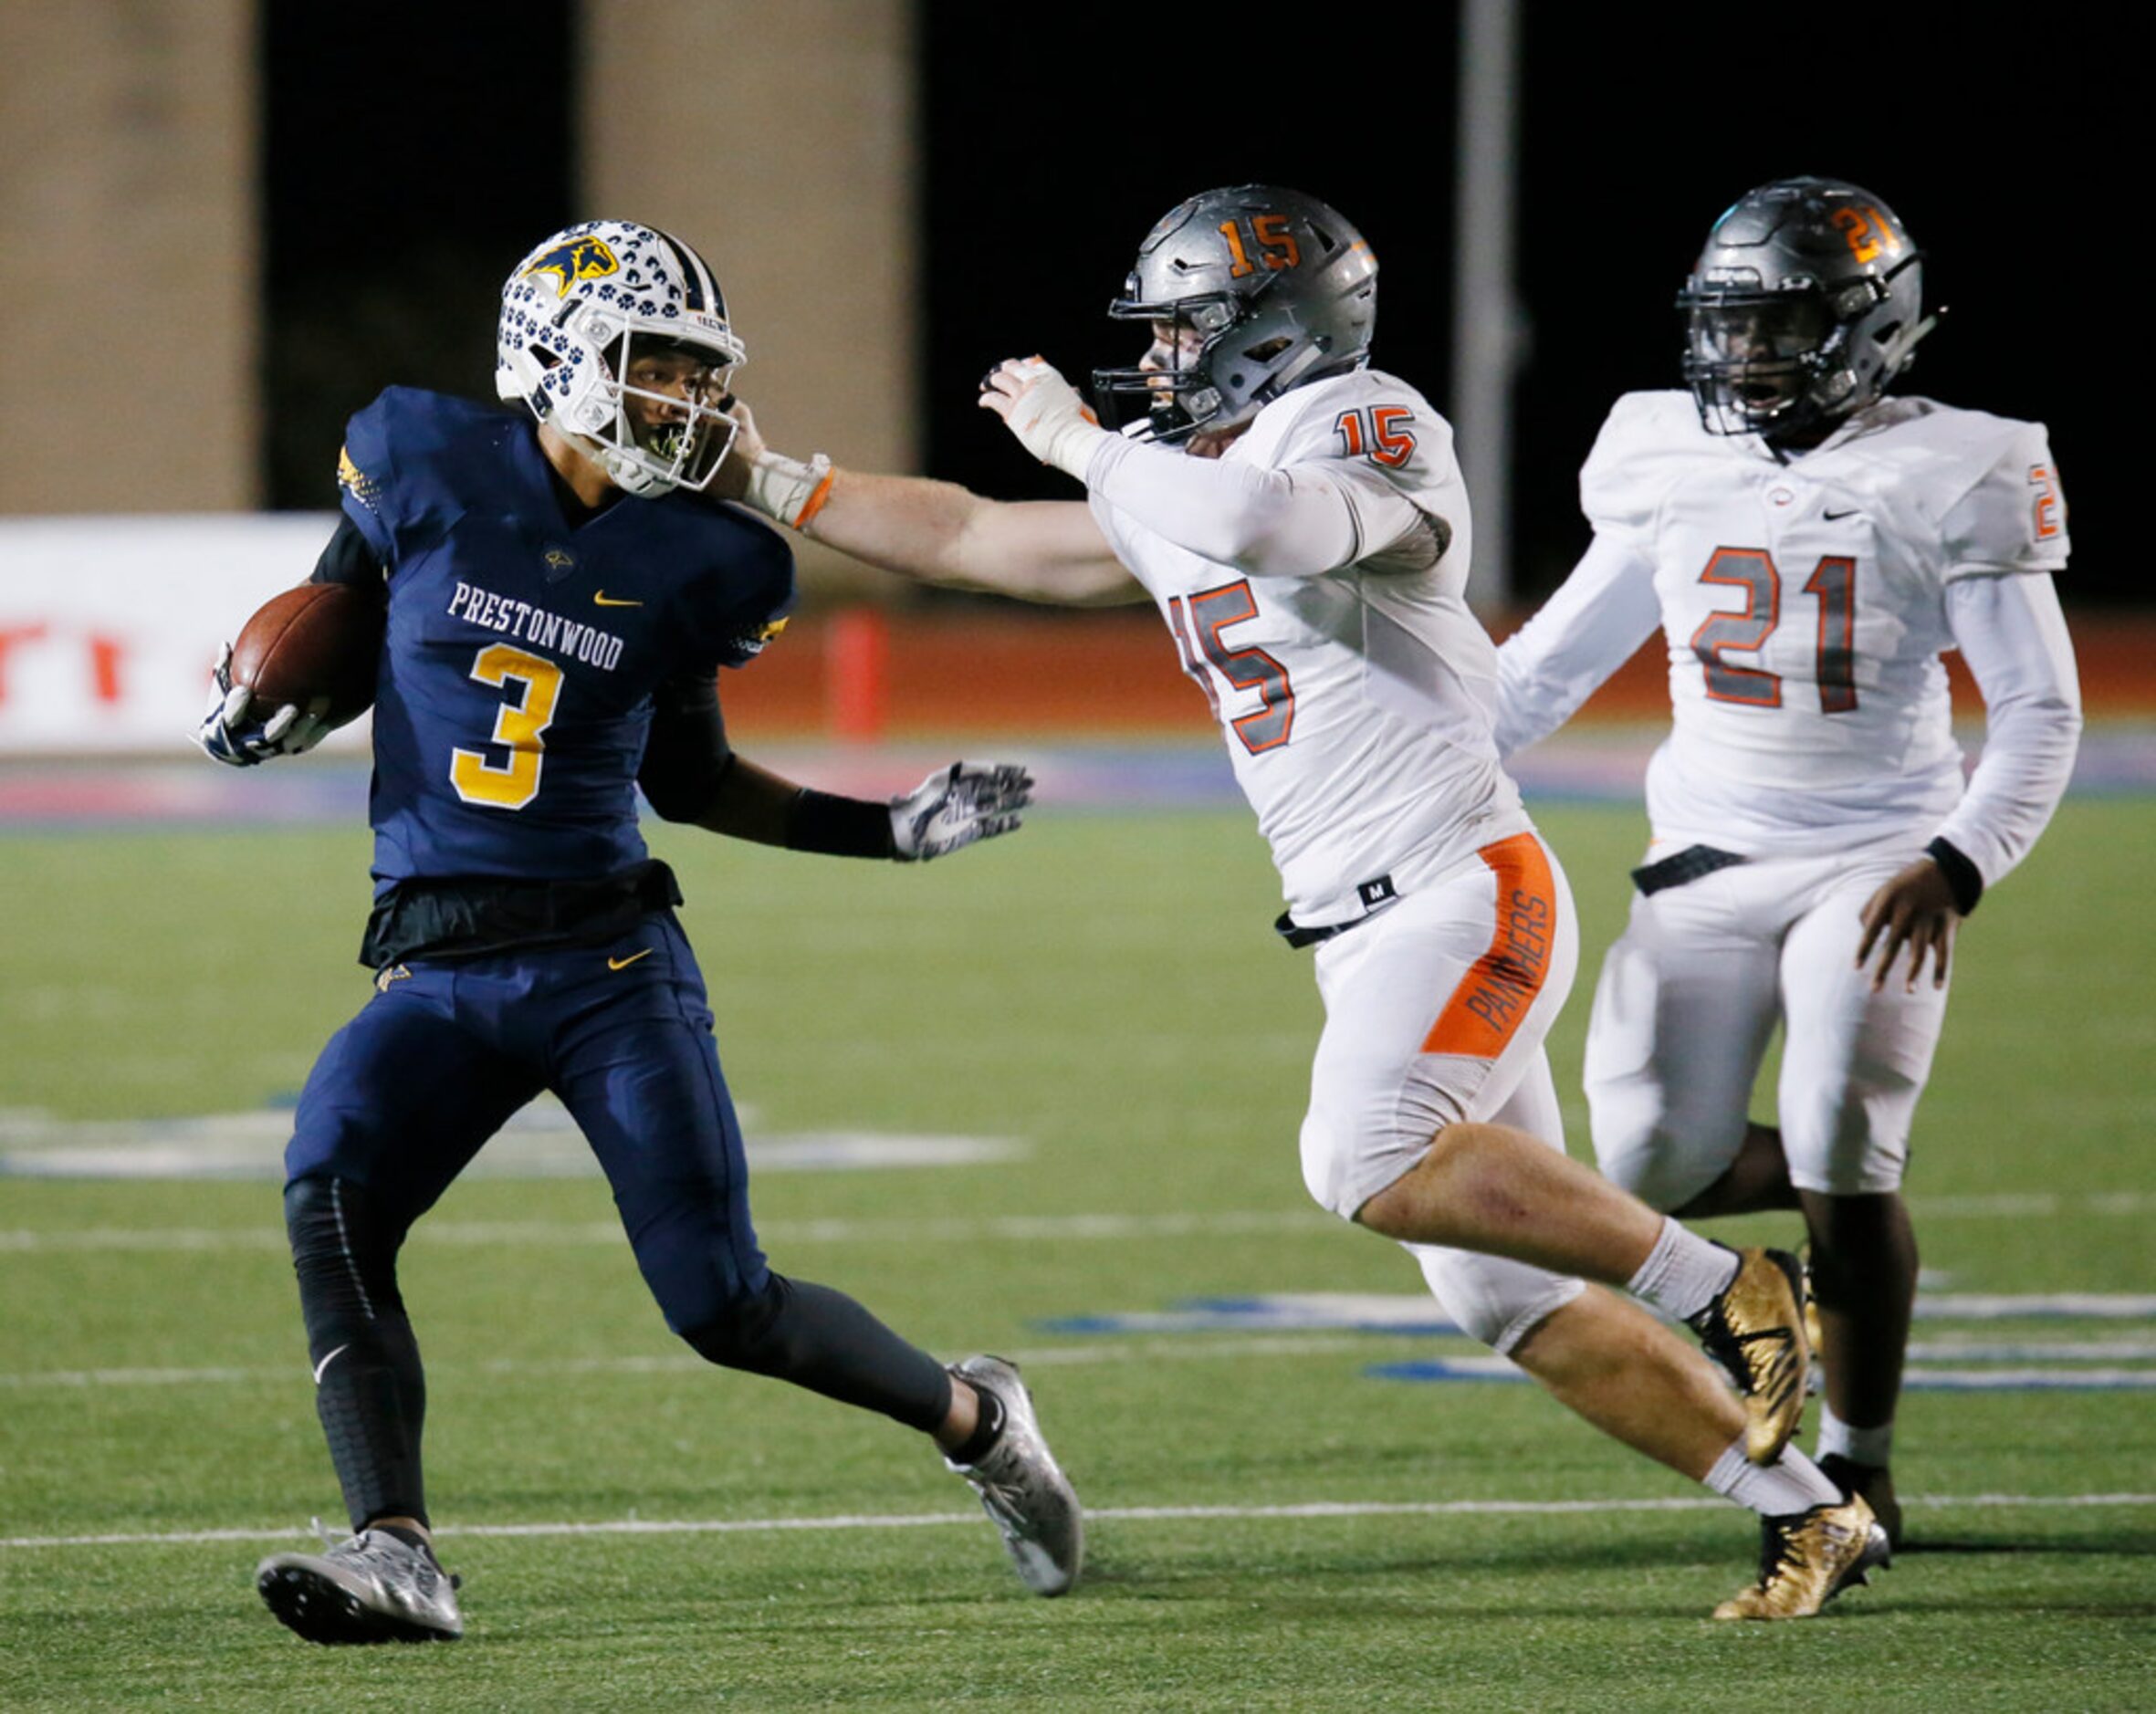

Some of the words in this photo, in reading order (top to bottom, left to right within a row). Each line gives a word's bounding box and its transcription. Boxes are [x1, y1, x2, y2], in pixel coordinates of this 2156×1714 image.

[1219, 214, 1302, 278] 15
[1831, 206, 1901, 264] 21
[1335, 404, 1418, 469] 15
[2028, 464, 2067, 543] 2
[447, 581, 624, 671] PRESTONWOOD
[1690, 545, 1858, 714] 21
[449, 642, 565, 810] 3
